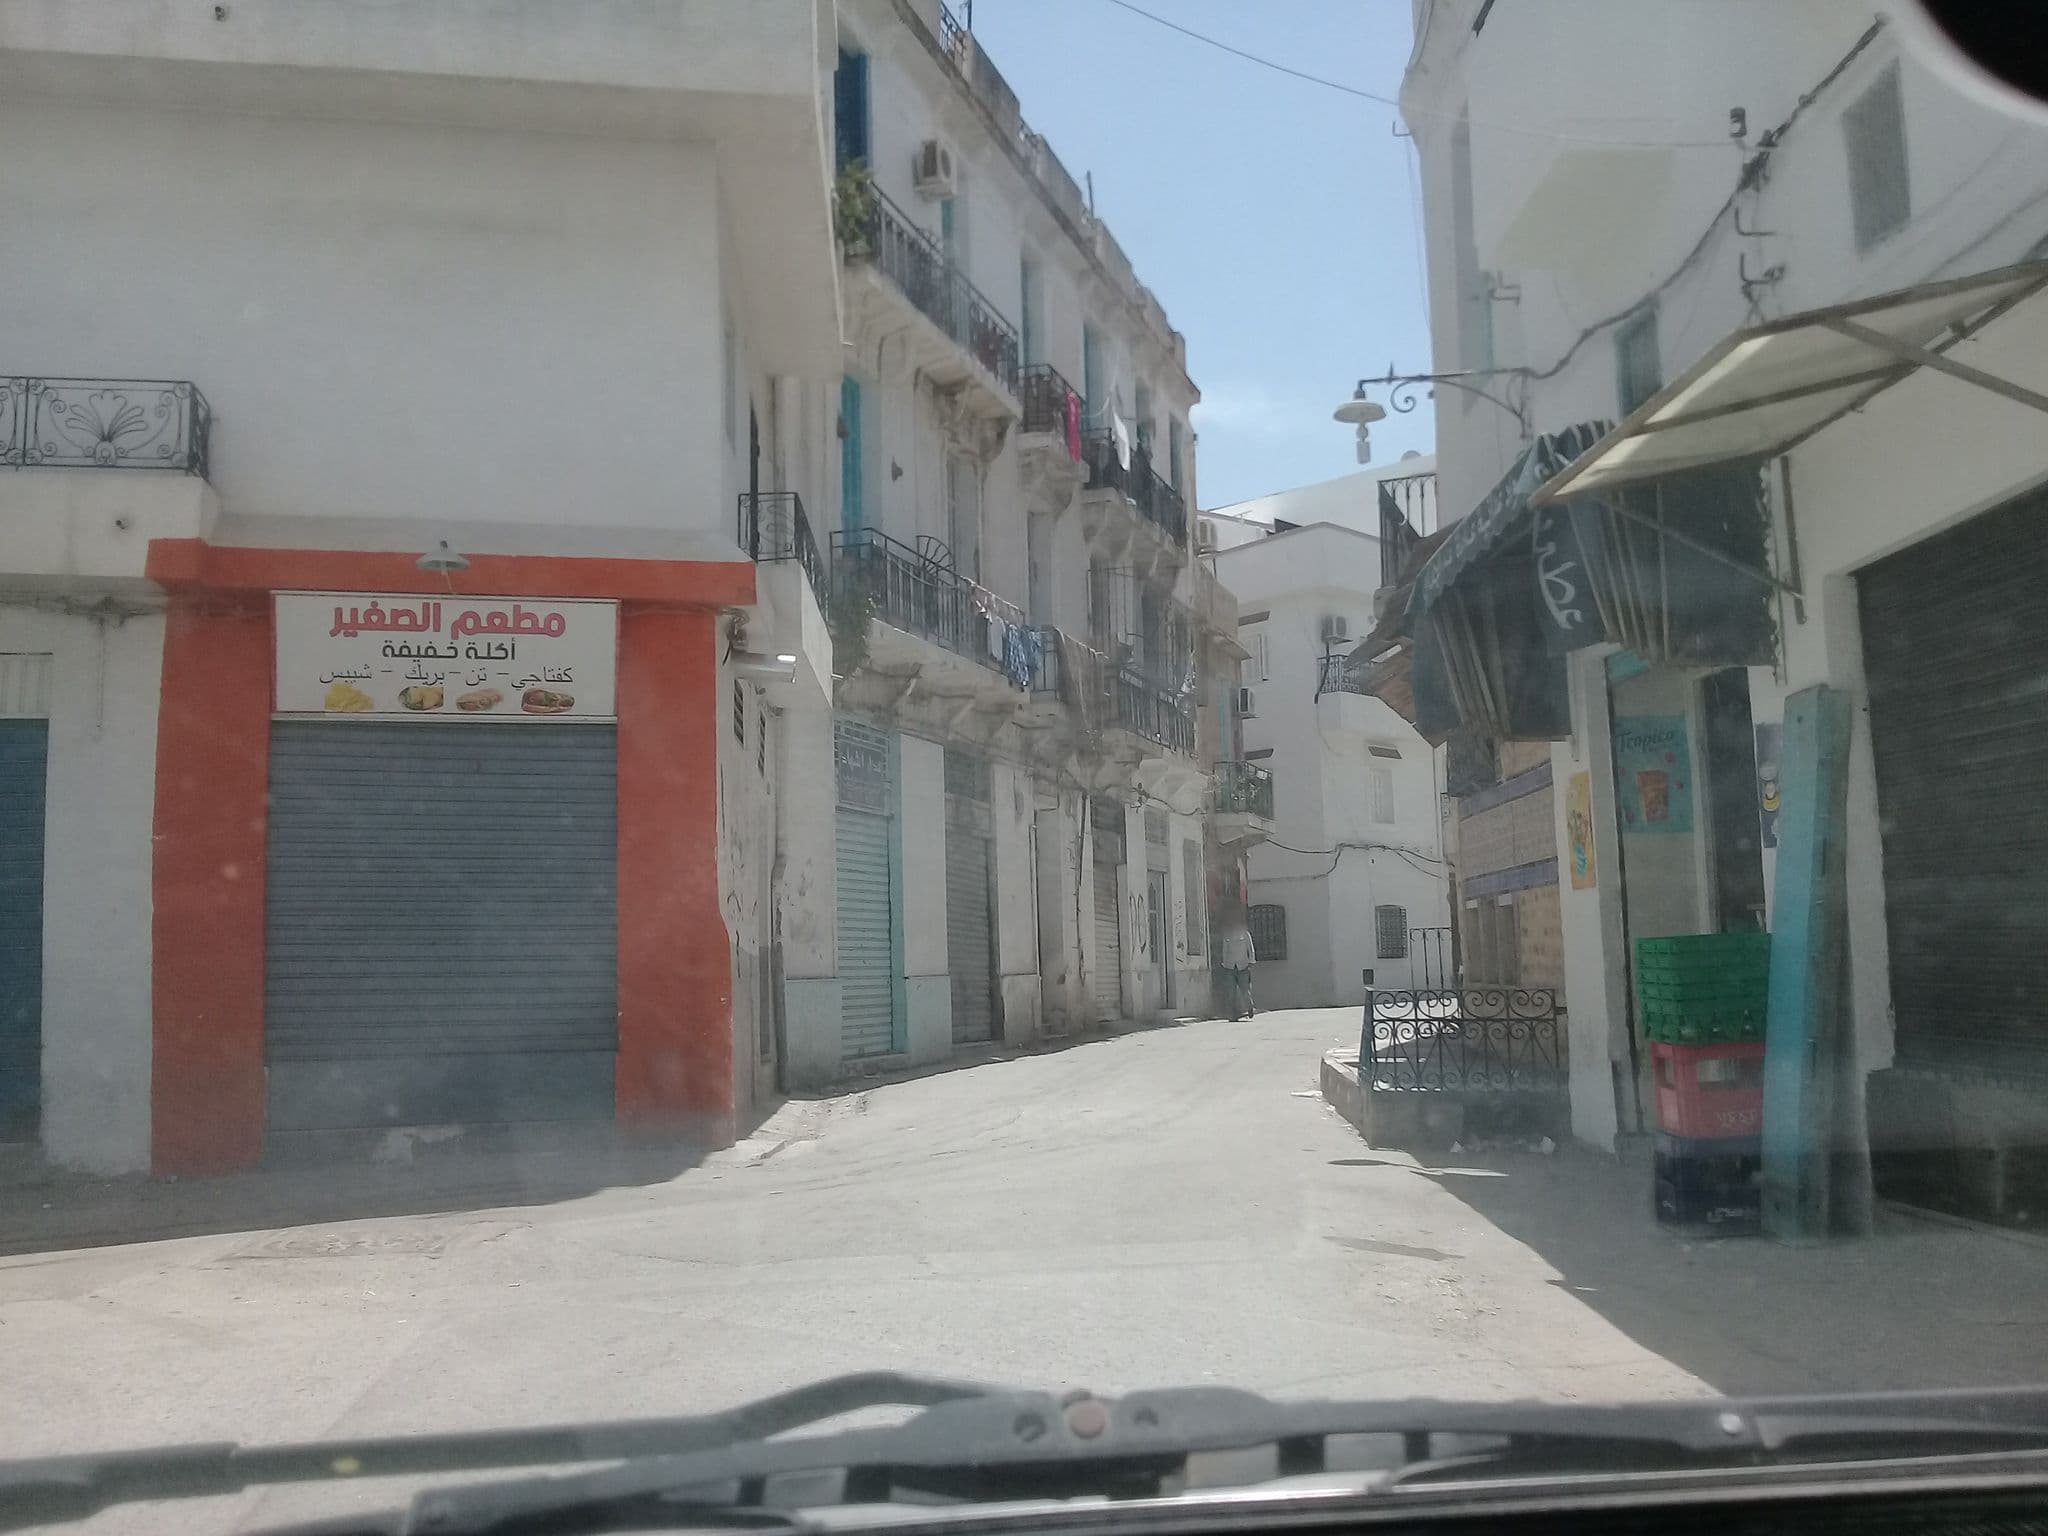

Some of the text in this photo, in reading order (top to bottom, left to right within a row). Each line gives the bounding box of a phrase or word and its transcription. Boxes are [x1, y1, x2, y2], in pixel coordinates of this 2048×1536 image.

[328, 600, 567, 641] مطعم الصغير
[381, 636, 516, 662] أكلة خفيفة
[404, 663, 445, 685] بريك
[465, 666, 488, 686] تن
[510, 665, 574, 691] كفتاجي
